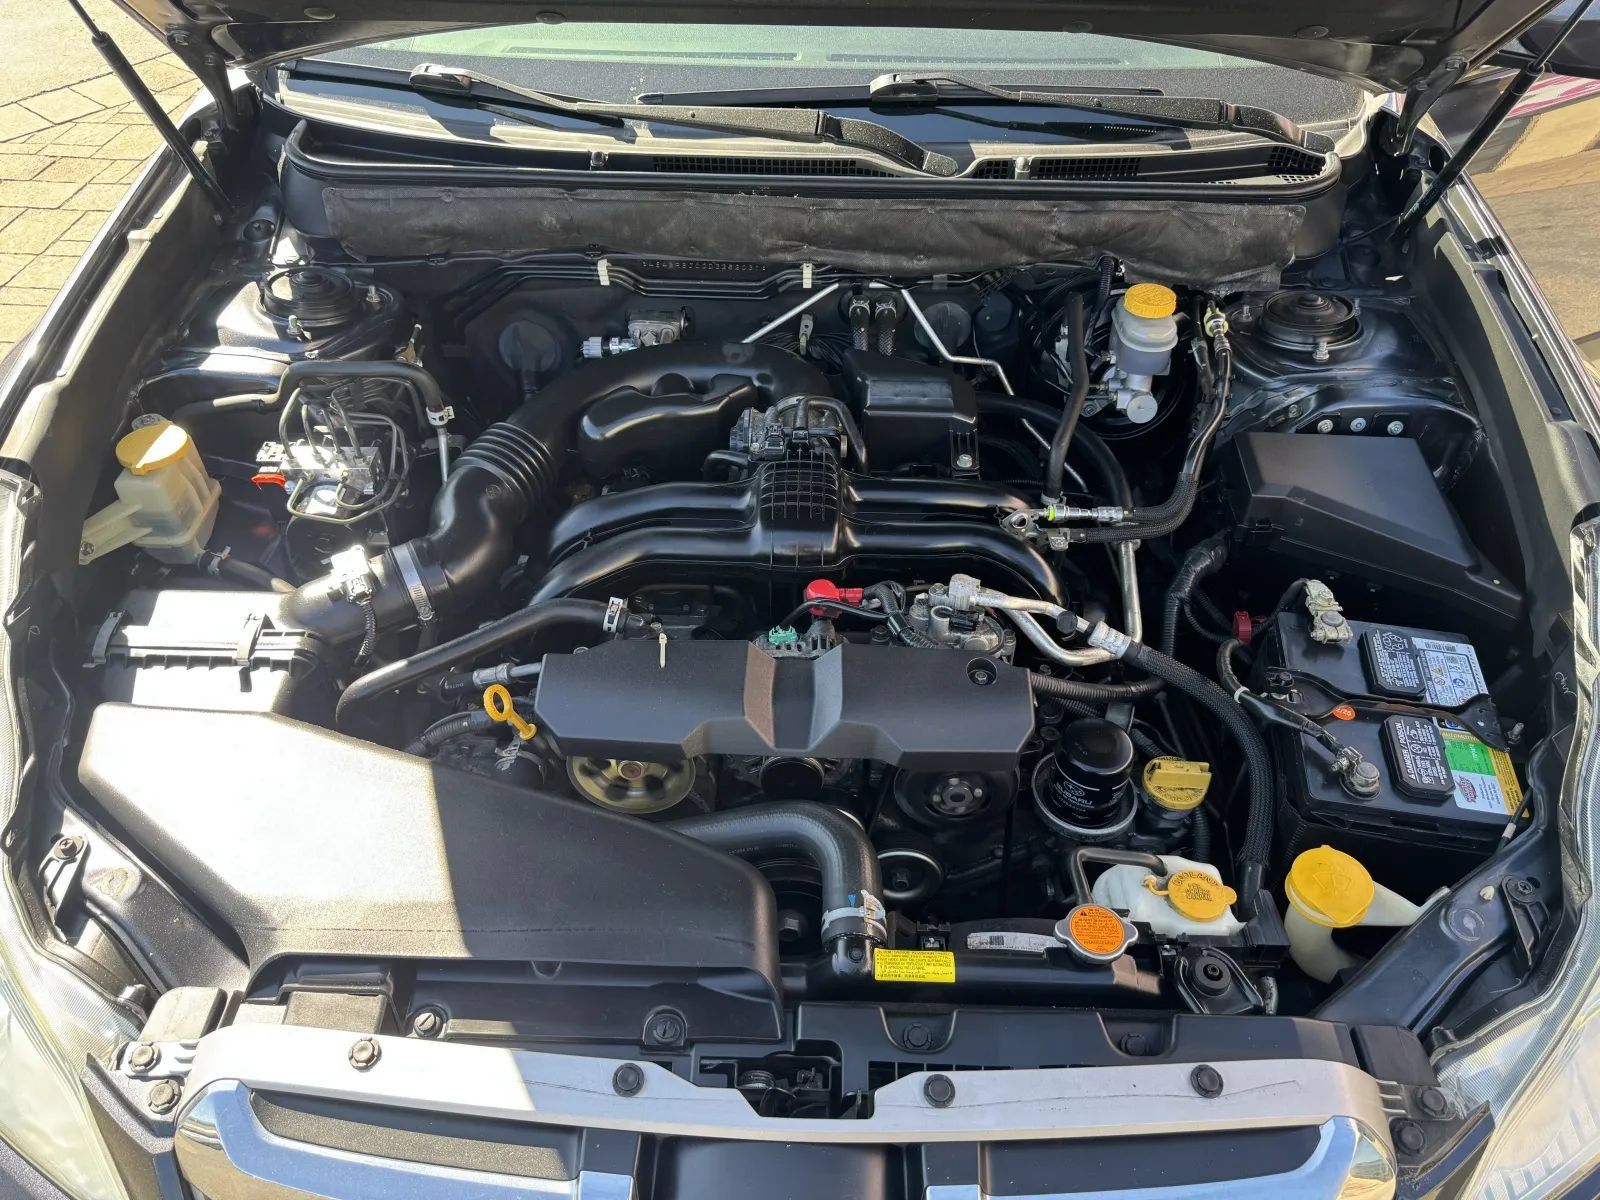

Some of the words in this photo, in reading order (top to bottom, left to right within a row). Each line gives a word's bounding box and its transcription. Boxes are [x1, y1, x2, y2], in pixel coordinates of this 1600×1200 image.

[1394, 722, 1406, 743] POISON
[1402, 749, 1414, 773] DANGER
[1056, 782, 1093, 805] SUBARU
[1172, 871, 1222, 887] COOLANT
